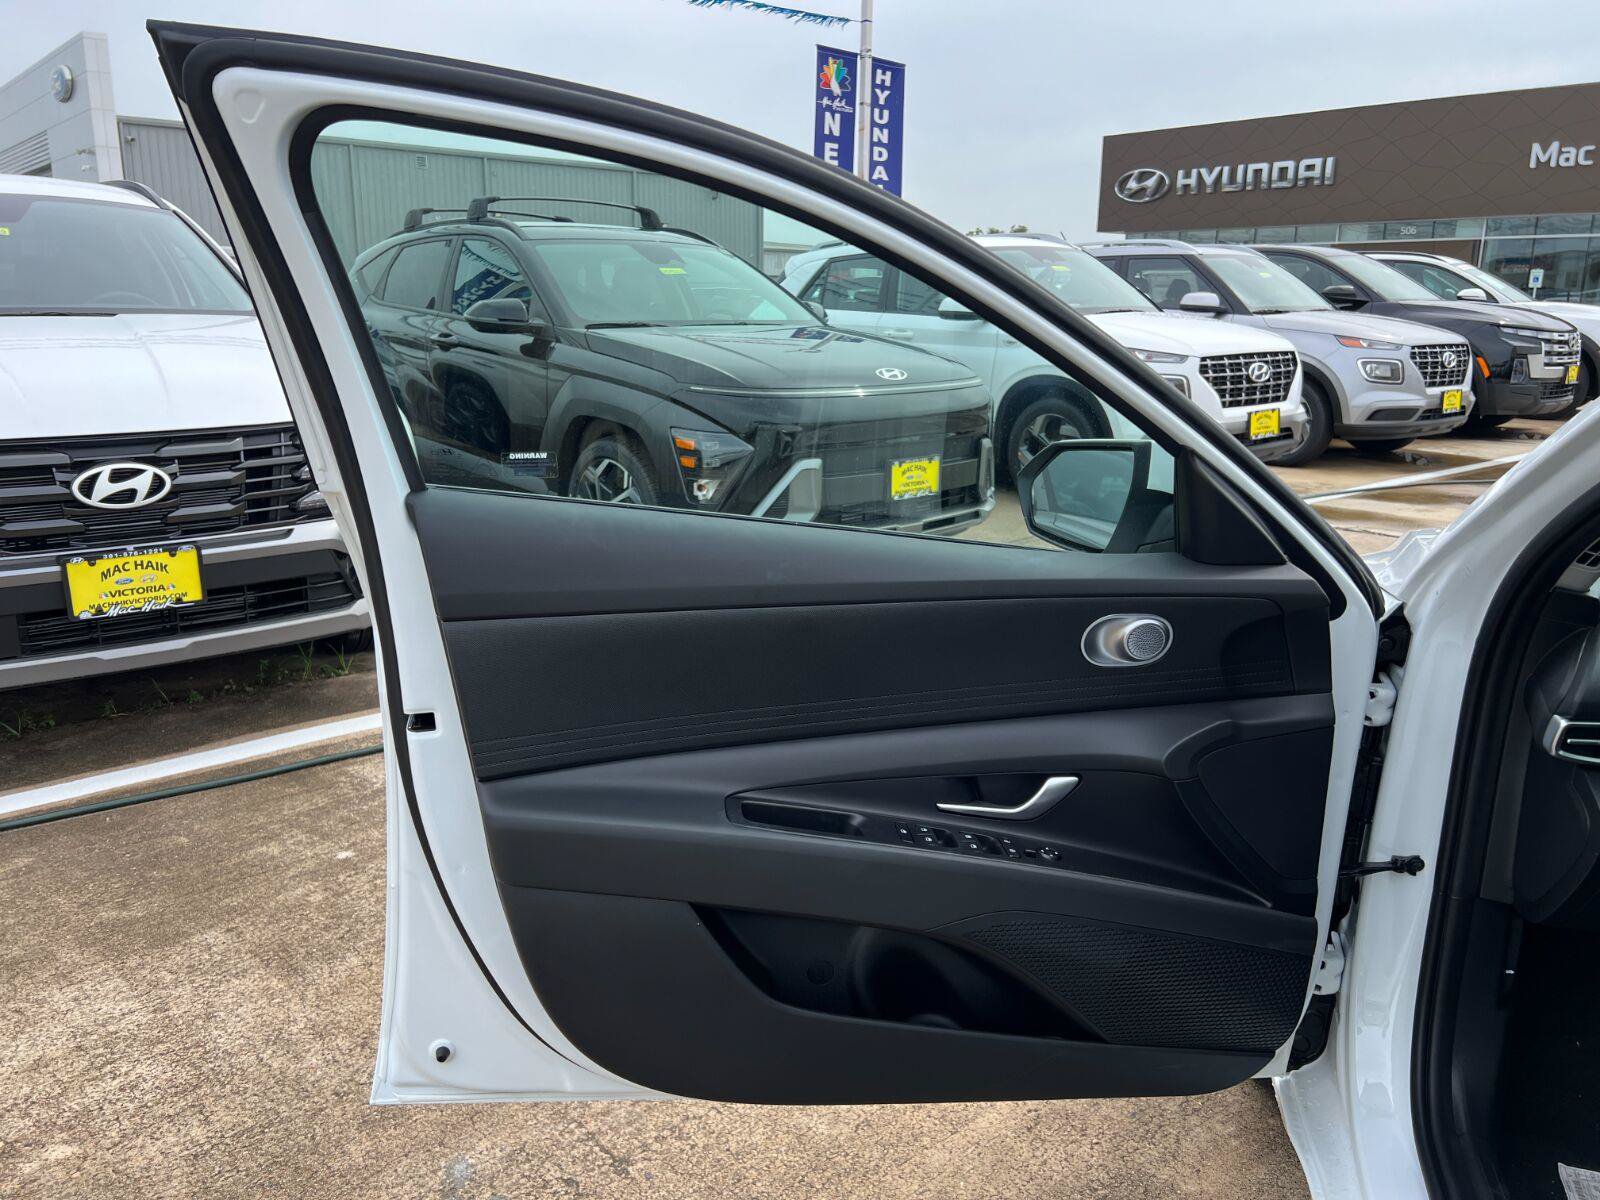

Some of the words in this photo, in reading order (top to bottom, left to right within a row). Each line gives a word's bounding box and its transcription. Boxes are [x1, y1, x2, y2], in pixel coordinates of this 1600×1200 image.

[1529, 140, 1596, 169] Mac
[1175, 156, 1336, 196] HYUNDAI
[101, 561, 130, 582] MAC
[134, 560, 169, 574] HAIK
[109, 584, 166, 598] VICTORIA
